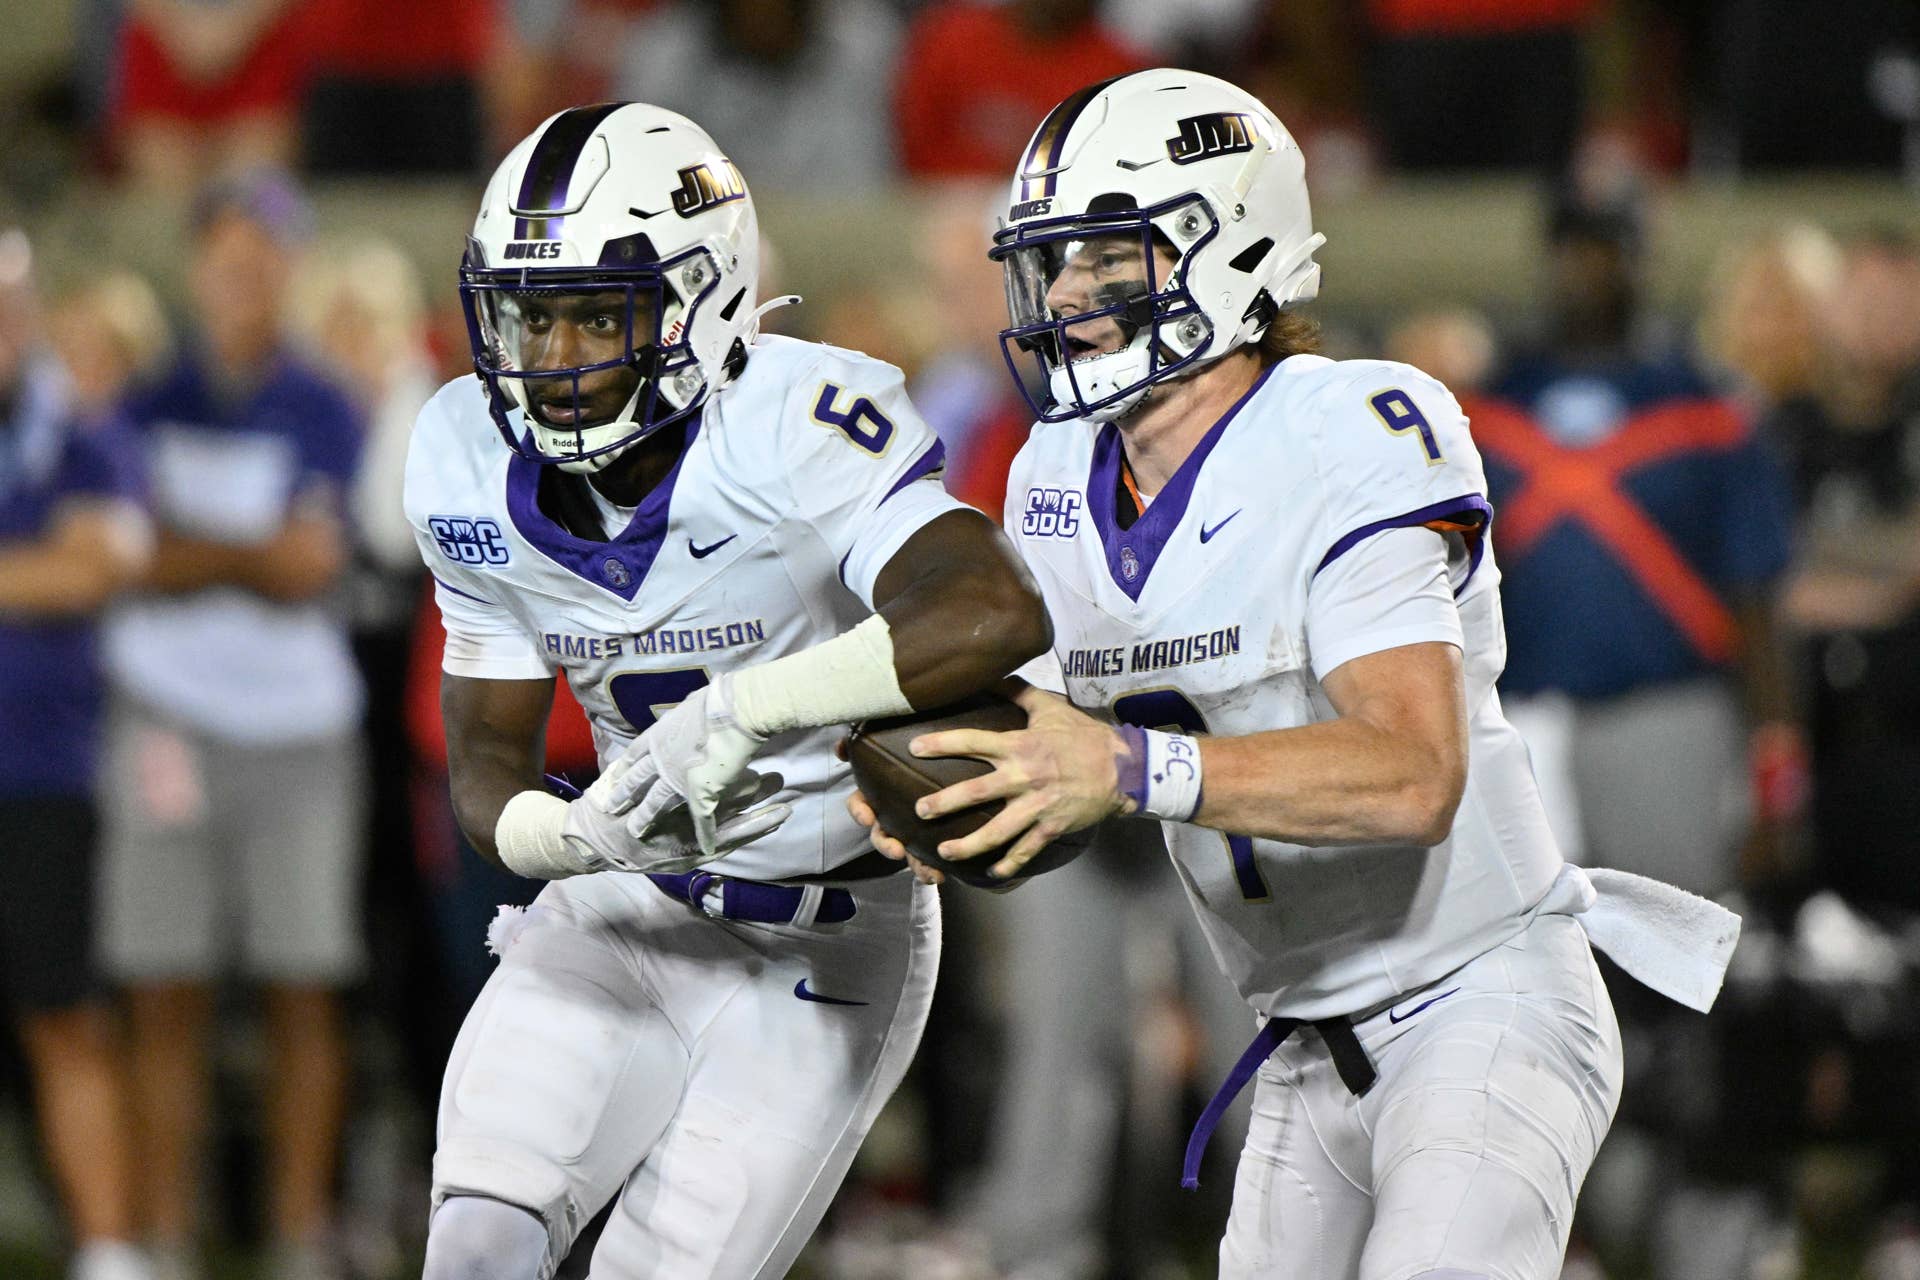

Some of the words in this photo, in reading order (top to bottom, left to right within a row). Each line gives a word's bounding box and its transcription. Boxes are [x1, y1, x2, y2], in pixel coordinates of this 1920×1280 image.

[1009, 198, 1053, 222] DUKES
[503, 242, 562, 260] DUKES
[809, 379, 898, 460] 6
[1365, 386, 1447, 467] 9
[1022, 487, 1082, 538] SBC
[428, 516, 510, 566] SBC
[539, 632, 624, 660] AMES
[634, 619, 766, 655] MADISON
[1064, 647, 1125, 678] JAMES
[1131, 625, 1241, 673] MADISON
